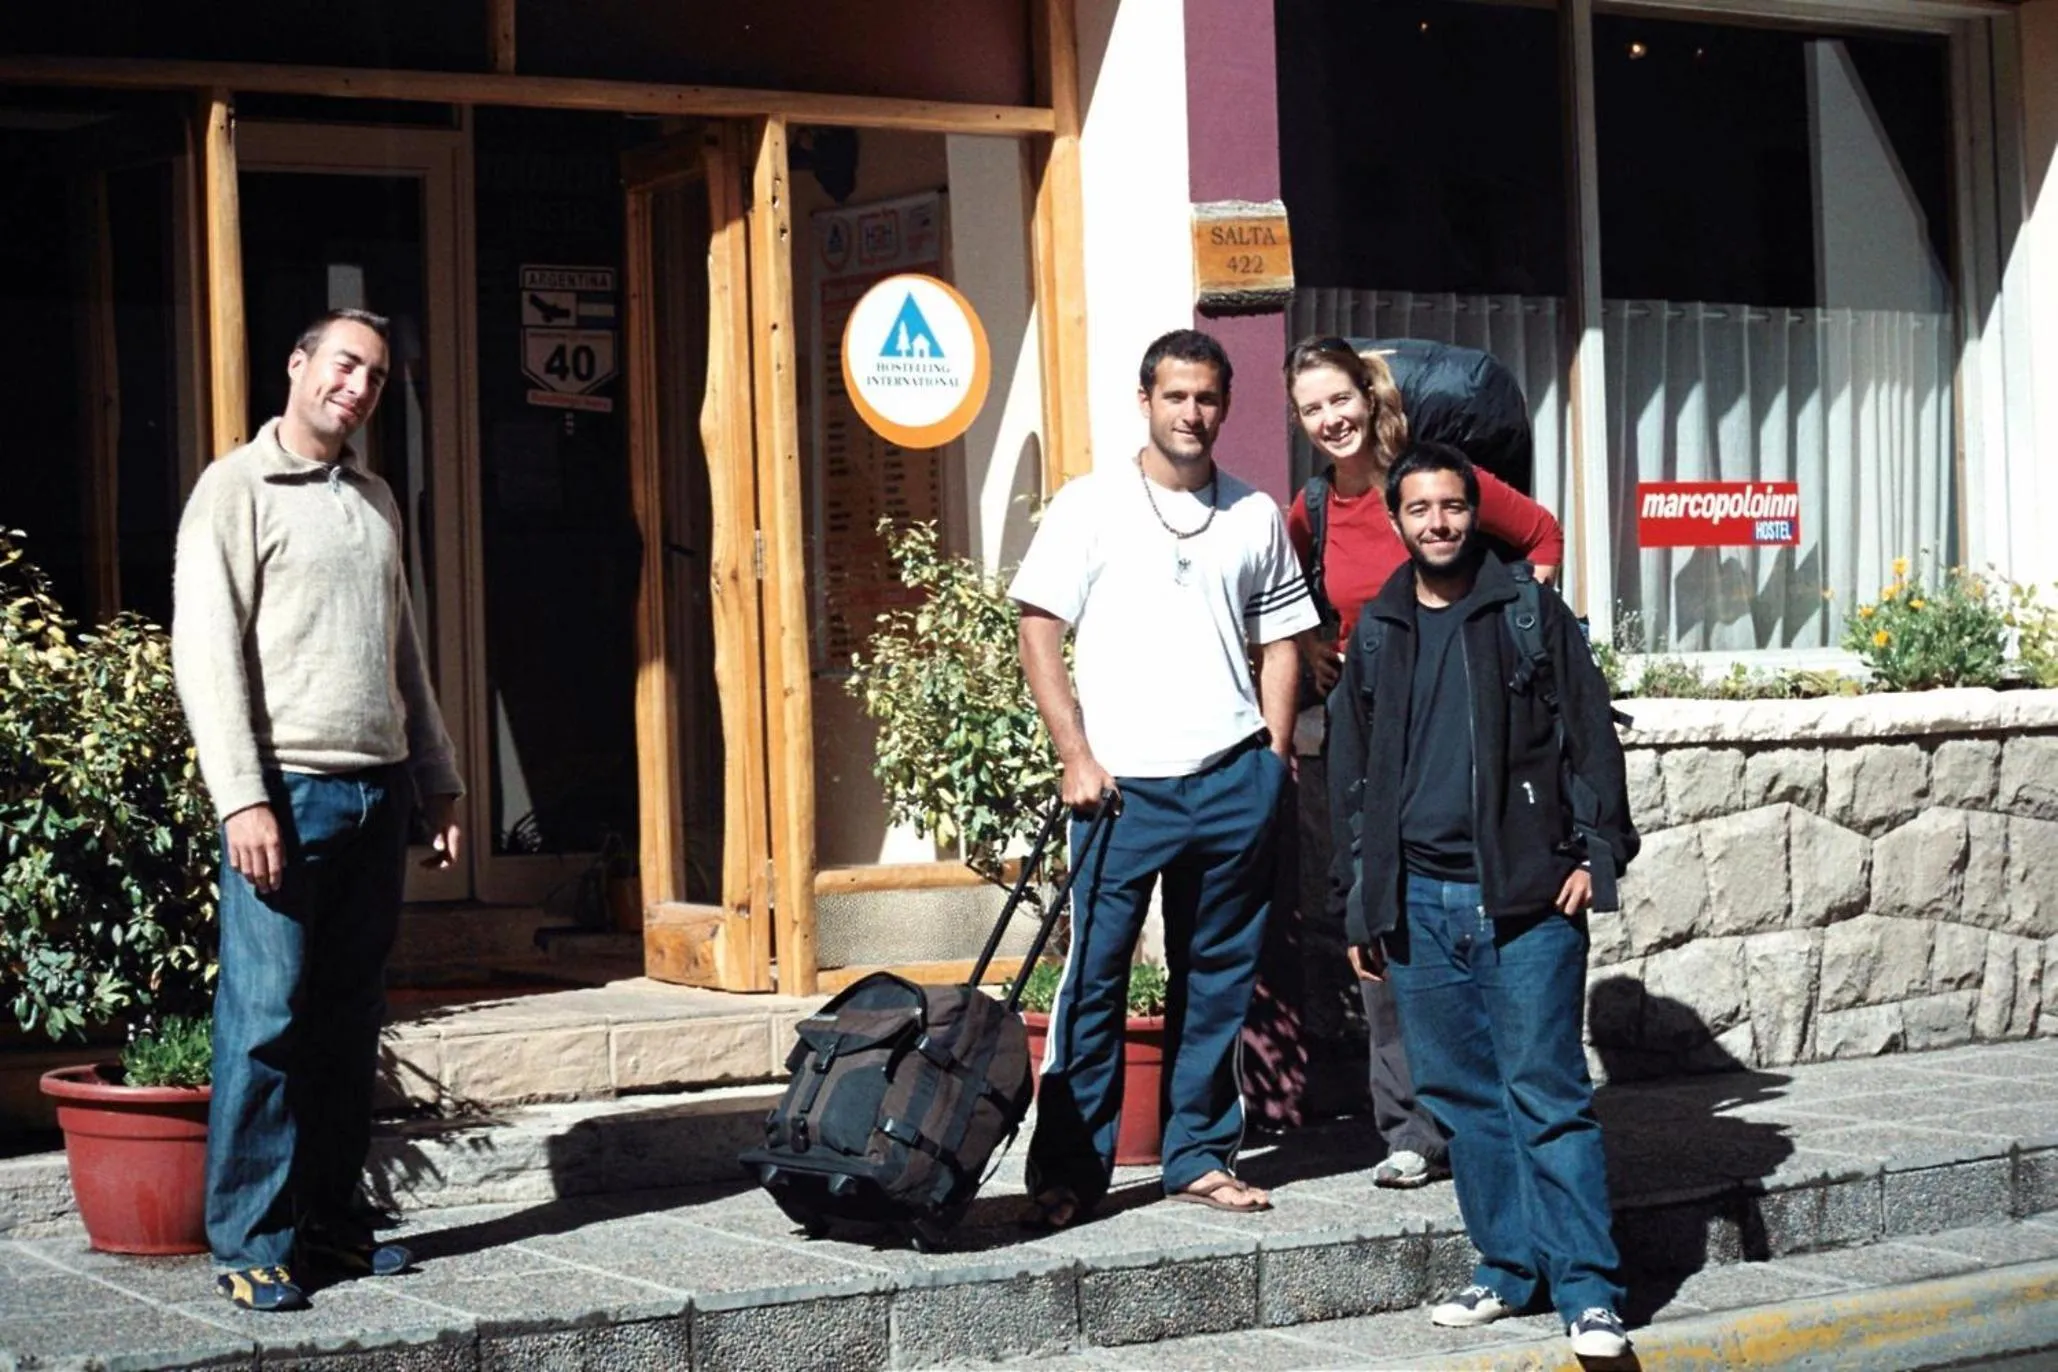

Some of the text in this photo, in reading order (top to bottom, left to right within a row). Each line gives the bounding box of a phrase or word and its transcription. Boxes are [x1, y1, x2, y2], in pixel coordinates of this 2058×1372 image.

[1211, 226, 1277, 245] SALTA
[1226, 255, 1265, 274] 422
[528, 272, 608, 288] ARGENTINA
[544, 343, 596, 382] 40
[866, 375, 959, 387] INTERNATIONAL
[1641, 485, 1798, 525] marcopoloinn
[1755, 520, 1792, 540] HOSTEL
